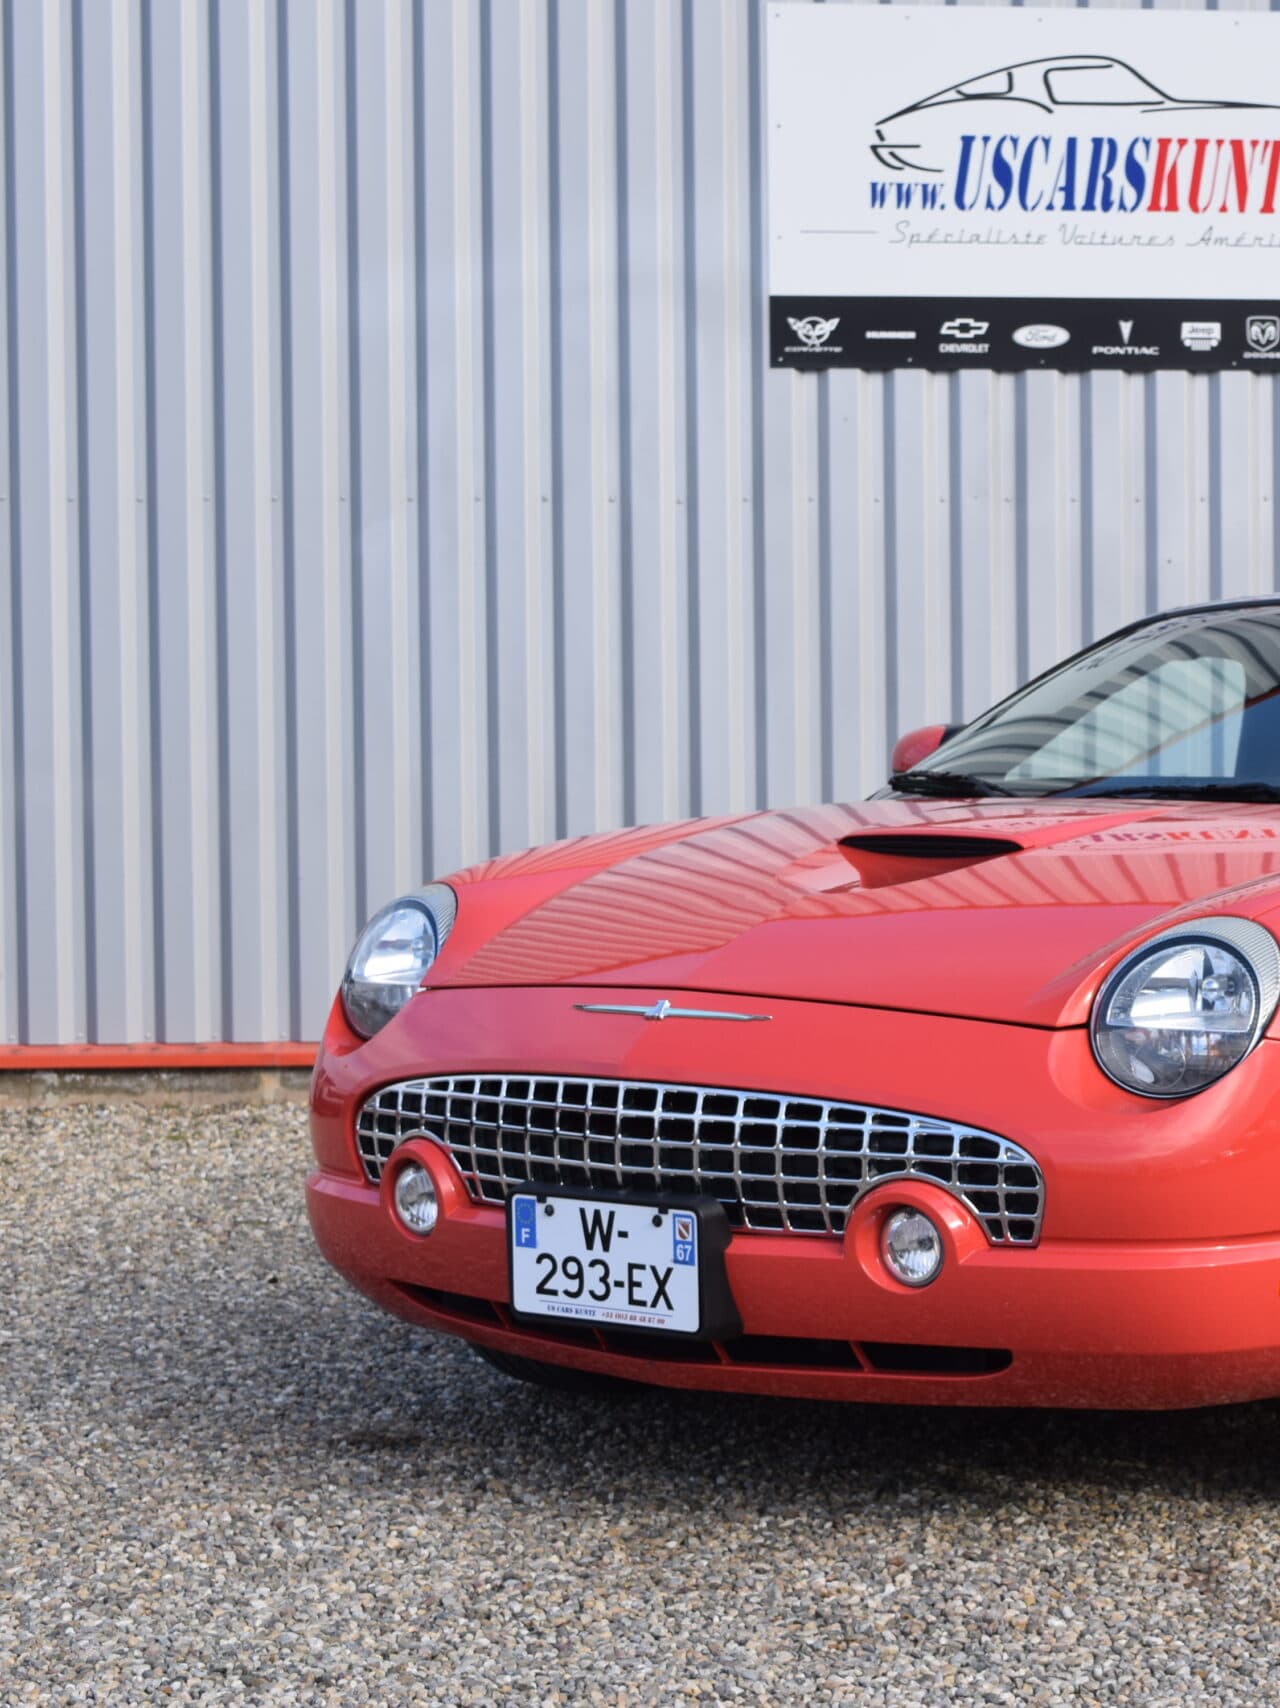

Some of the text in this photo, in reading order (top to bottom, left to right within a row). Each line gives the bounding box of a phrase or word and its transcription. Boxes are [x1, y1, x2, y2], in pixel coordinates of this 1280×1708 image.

[1058, 222, 1175, 247] Voitures
[1024, 328, 1058, 343] Ford
[1188, 325, 1215, 336] Jeep
[938, 343, 990, 354] CHEVROLET
[1091, 345, 1160, 356] PONTIAC
[520, 1228, 531, 1244] F
[675, 1246, 692, 1262] 67
[535, 1252, 674, 1312] 293-EX
